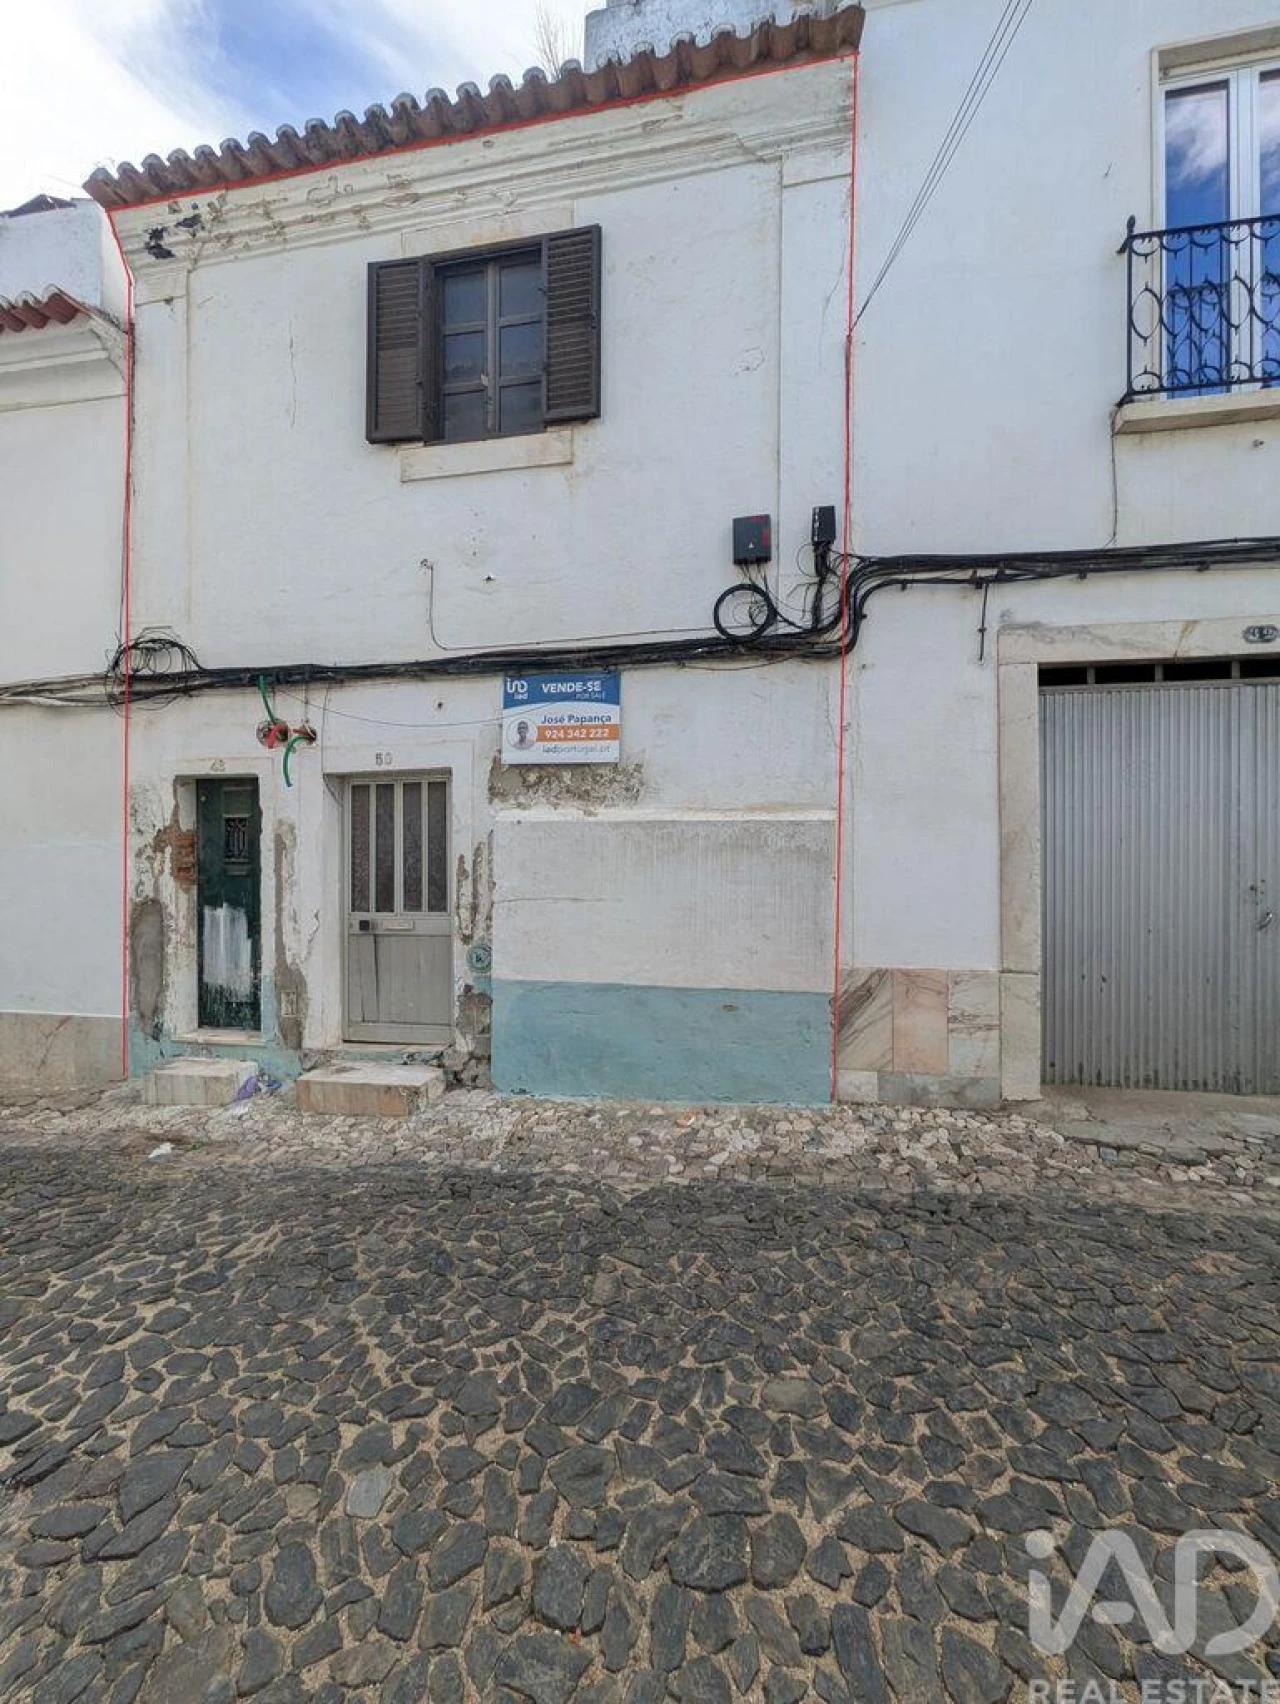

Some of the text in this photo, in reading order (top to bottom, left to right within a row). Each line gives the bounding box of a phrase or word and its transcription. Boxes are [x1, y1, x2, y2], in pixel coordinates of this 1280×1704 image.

[541, 681, 602, 693] VENDE-SE
[567, 713, 612, 727] Papança
[545, 730, 564, 738] 924
